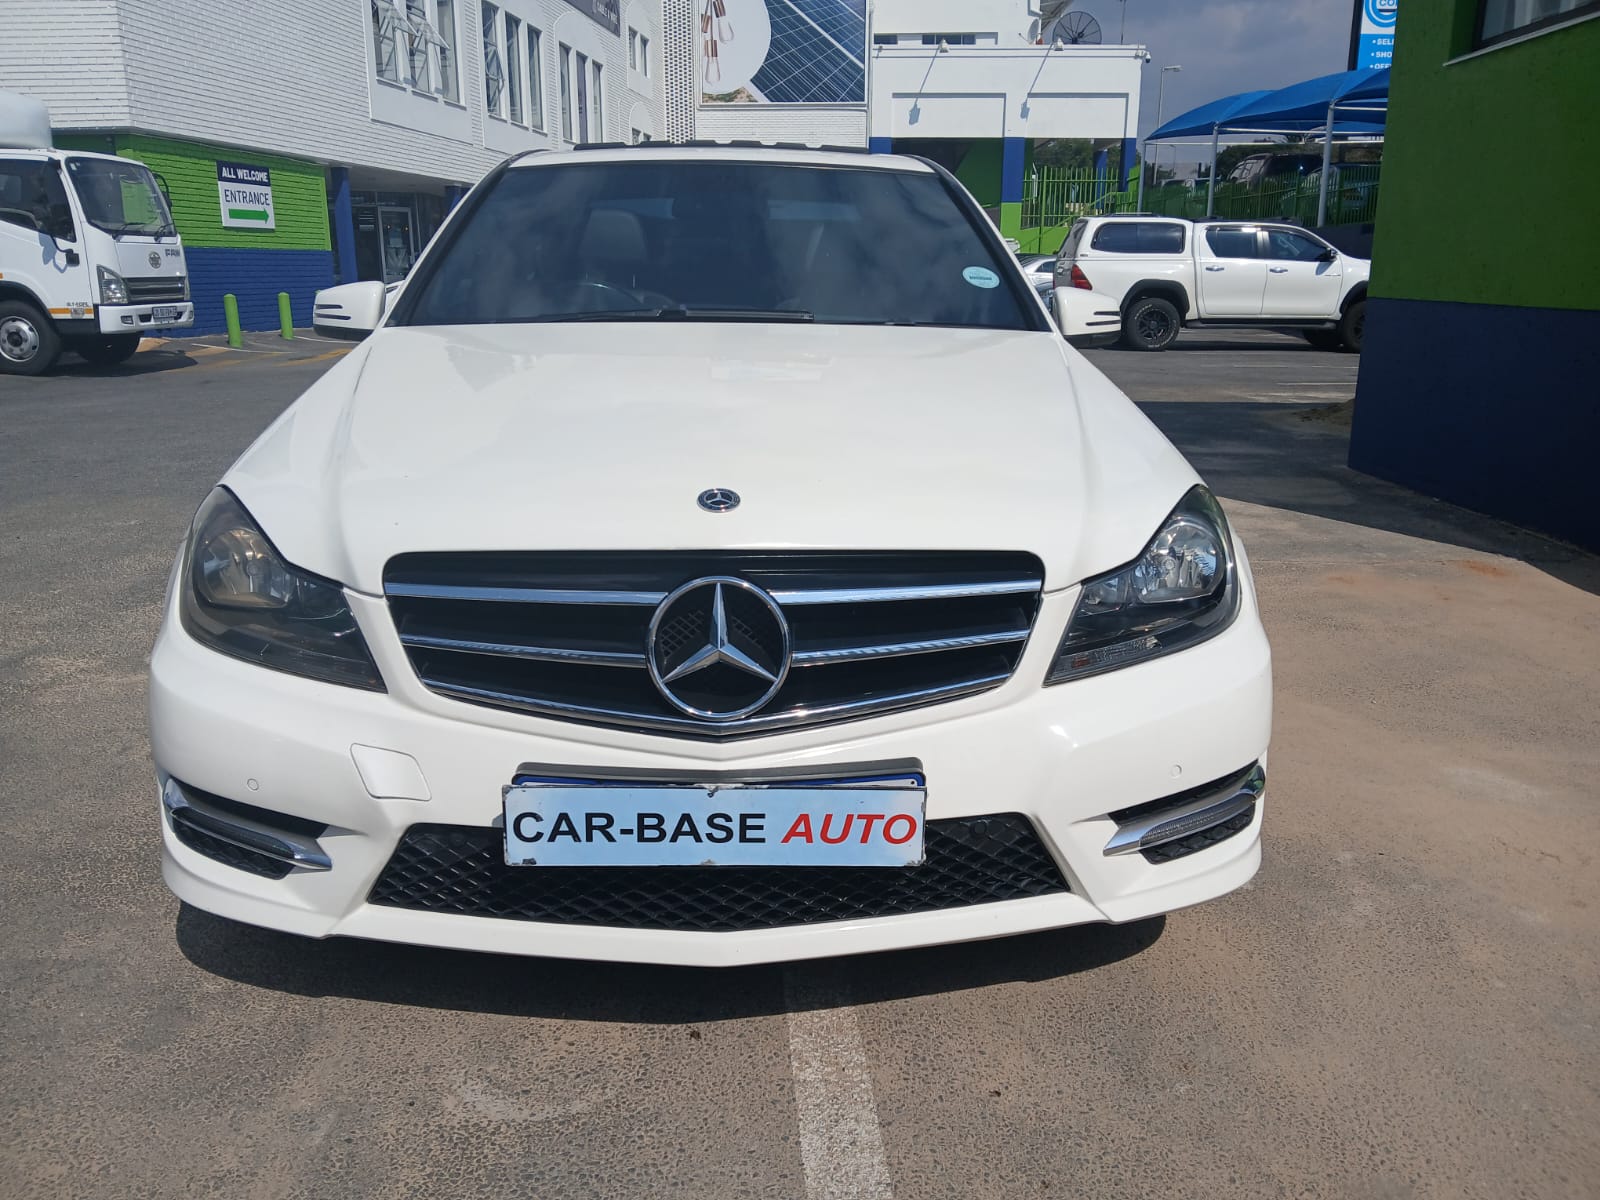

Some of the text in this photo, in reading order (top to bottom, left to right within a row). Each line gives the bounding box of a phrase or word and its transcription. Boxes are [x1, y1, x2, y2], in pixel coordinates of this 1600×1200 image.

[222, 166, 269, 182] ALL WELCOME
[224, 189, 270, 206] ENTRANCE
[513, 811, 918, 845] CAR-BASE AUTO
